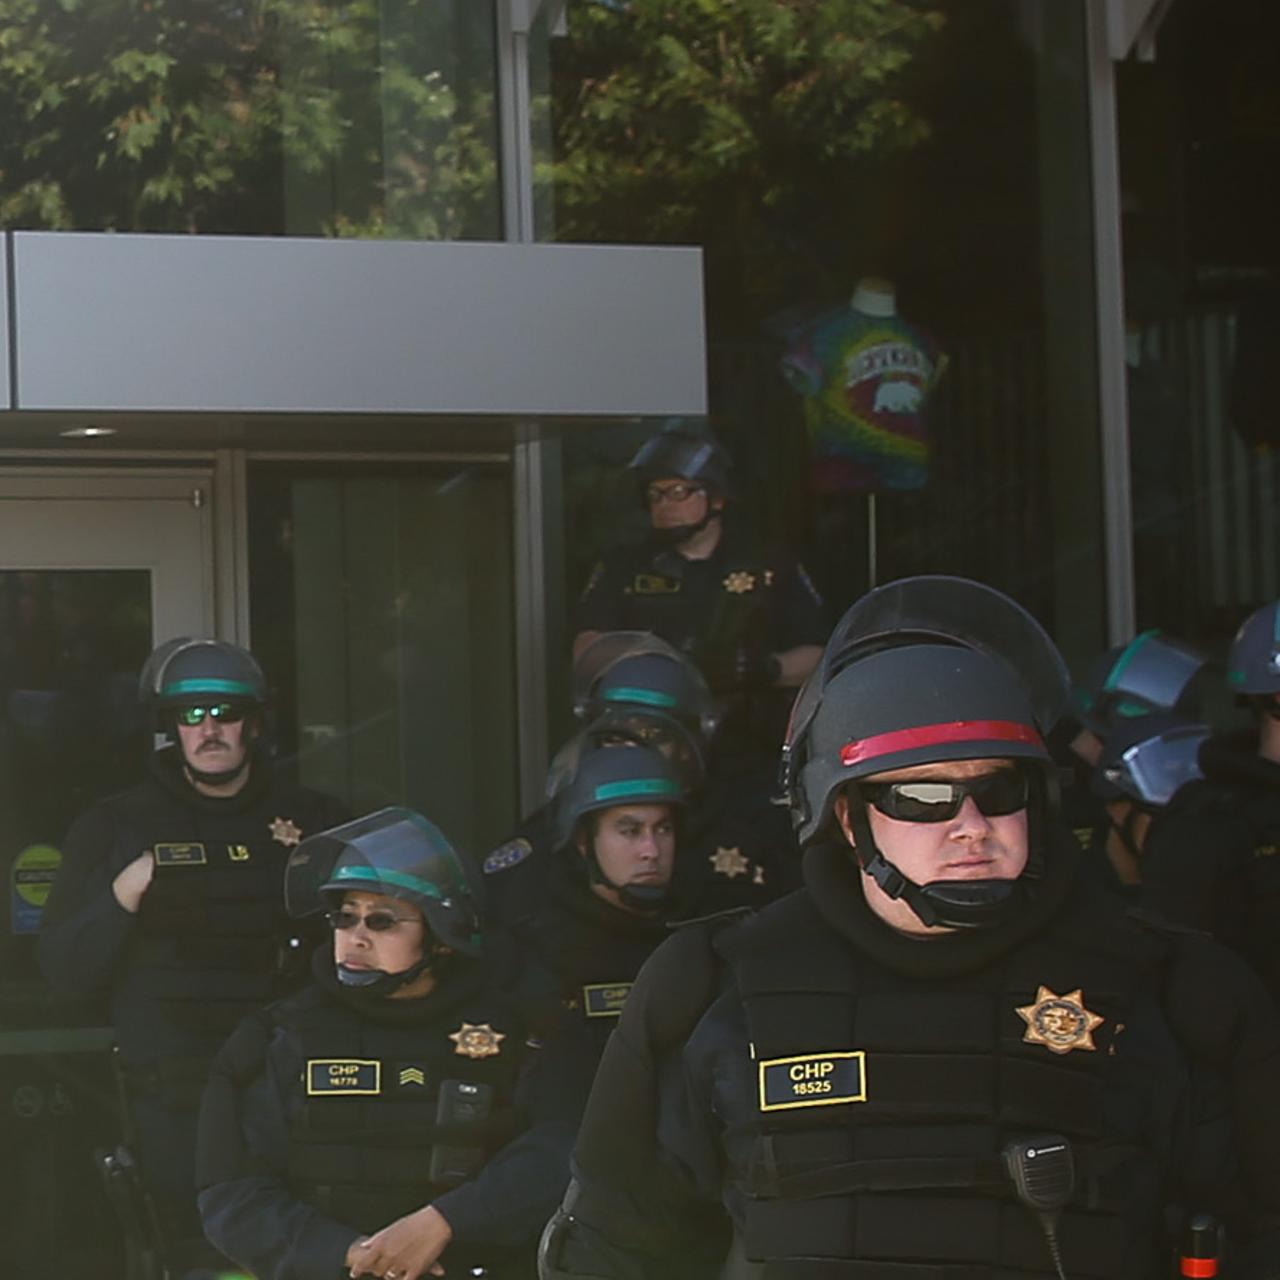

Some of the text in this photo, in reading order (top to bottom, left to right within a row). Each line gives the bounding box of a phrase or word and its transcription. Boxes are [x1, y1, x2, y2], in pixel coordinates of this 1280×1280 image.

[328, 1064, 360, 1076] CHP
[789, 1061, 834, 1081] CHP
[792, 1080, 832, 1095] 18525
